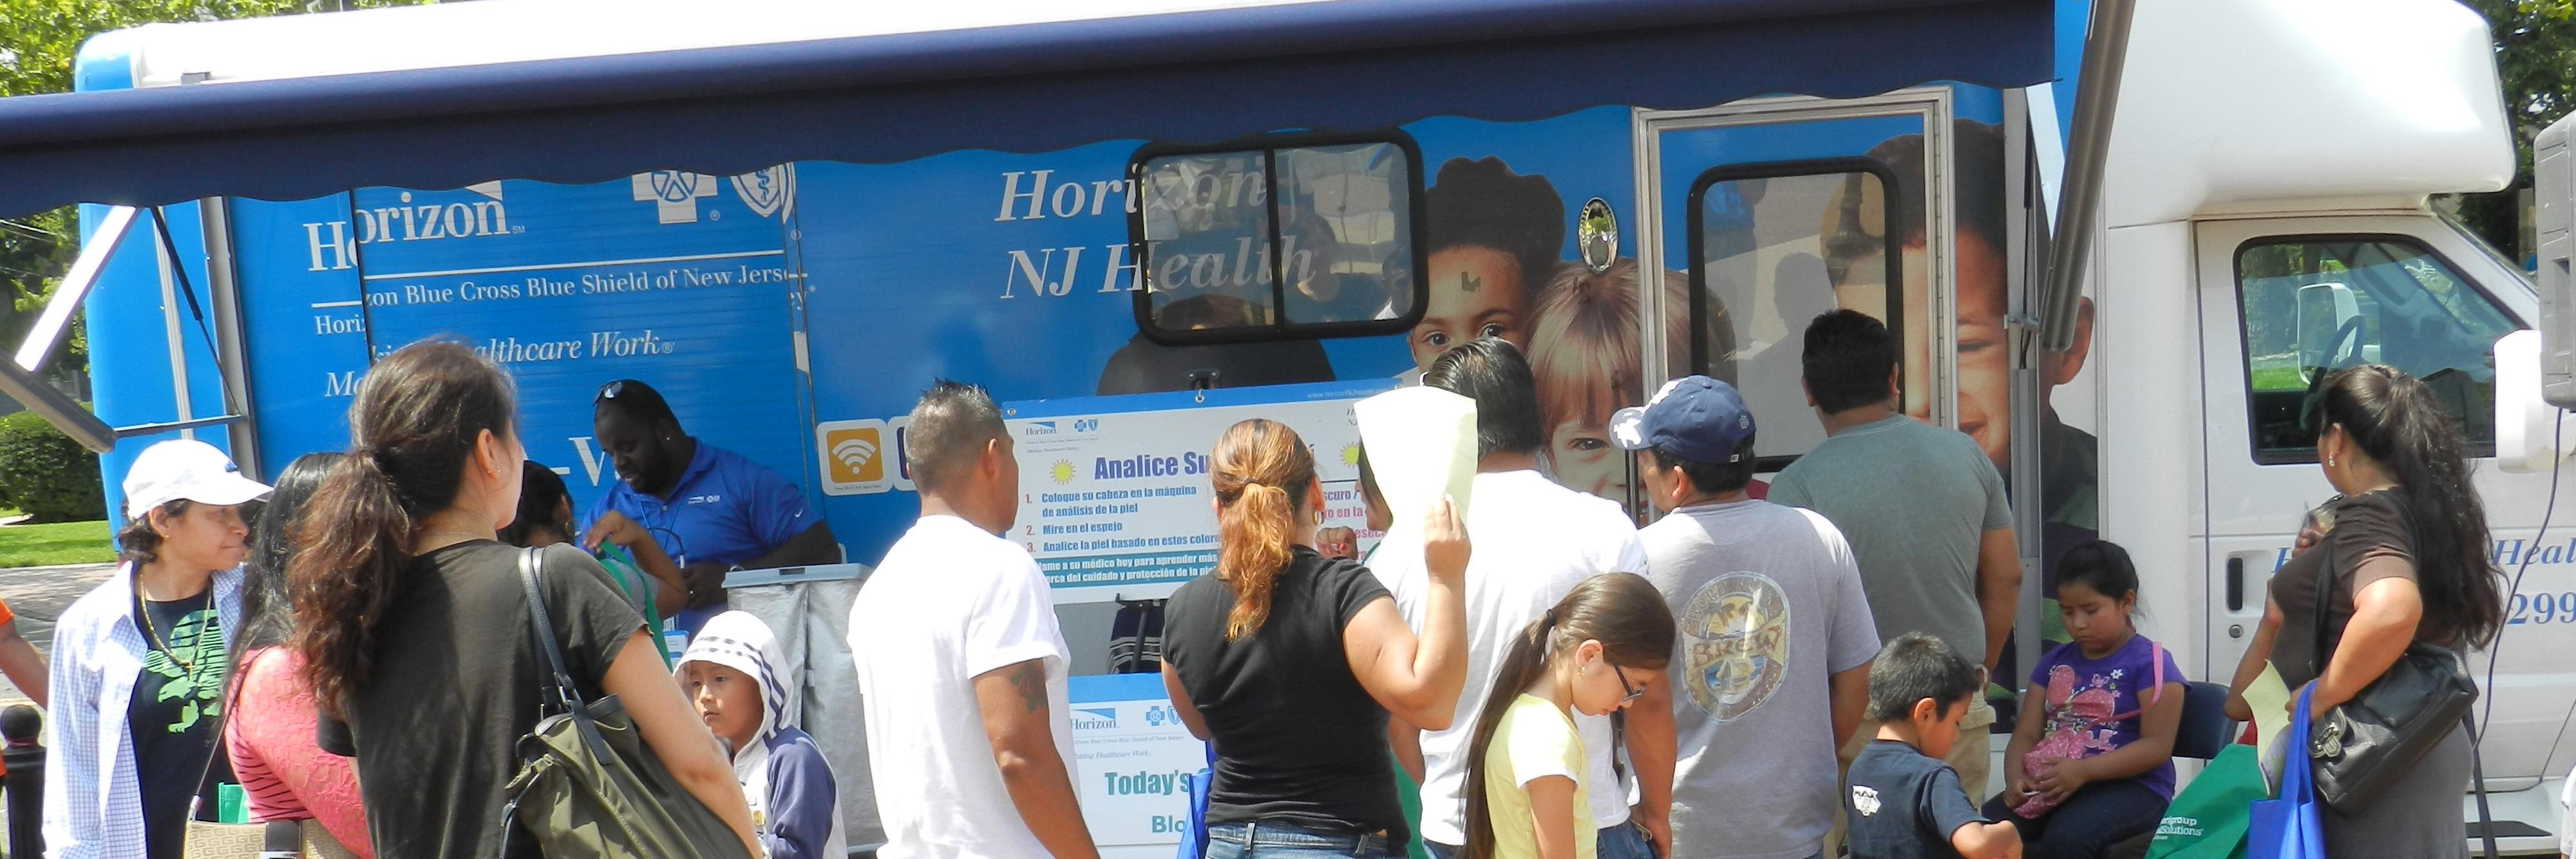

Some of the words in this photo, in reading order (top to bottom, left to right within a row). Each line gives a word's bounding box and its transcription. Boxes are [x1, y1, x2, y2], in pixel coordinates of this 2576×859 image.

[1000, 247, 1086, 299] NJ
[1097, 234, 1317, 293] Health
[405, 285, 453, 305] Blue
[460, 281, 520, 301] Cross
[527, 278, 576, 297] Blue
[582, 271, 650, 294] Shield
[656, 269, 677, 289] of
[683, 267, 733, 287] New
[475, 337, 582, 364] althcare
[1026, 426, 1056, 436] Horizon
[1095, 453, 1179, 480] Analice
[1025, 494, 1032, 504] 1.
[1042, 491, 1080, 503] Coloque
[1083, 492, 1094, 501] su
[1095, 489, 1128, 500] cabeza
[1130, 489, 1142, 498] en
[1144, 487, 1153, 497] la
[1155, 486, 1197, 497] máquina
[1042, 507, 1054, 517] de
[1056, 505, 1094, 516] análisis
[1095, 504, 1107, 514] de
[1109, 504, 1118, 514] la
[1120, 503, 1138, 514] piel
[1336, 507, 1350, 518] en
[1353, 506, 1363, 516] la
[1027, 525, 1035, 536] 2.
[1043, 525, 1064, 534] Mire
[1066, 525, 1077, 534] en
[1080, 524, 1088, 533] el
[1091, 522, 1122, 533] espejo
[1027, 542, 1036, 552] 3.
[1043, 542, 1078, 552] Analice
[1081, 540, 1089, 550] la
[1092, 539, 1109, 550] piel
[1112, 538, 1146, 548] basado
[1148, 537, 1159, 547] en
[1162, 536, 1188, 545] estos
[1063, 562, 1068, 570] a
[1070, 561, 1080, 570] su
[1082, 558, 1115, 569] médico
[1117, 558, 1133, 569] hoy
[1135, 558, 1155, 567] para
[1156, 554, 1197, 565] aprender
[1199, 552, 1218, 563] más
[1066, 572, 1081, 582] del
[1083, 571, 1119, 581] cuidado
[1120, 572, 1125, 581] y
[1126, 569, 1175, 580] protección
[1176, 567, 1188, 578] de
[1189, 567, 1198, 576] la
[1105, 769, 1189, 796] Today's
